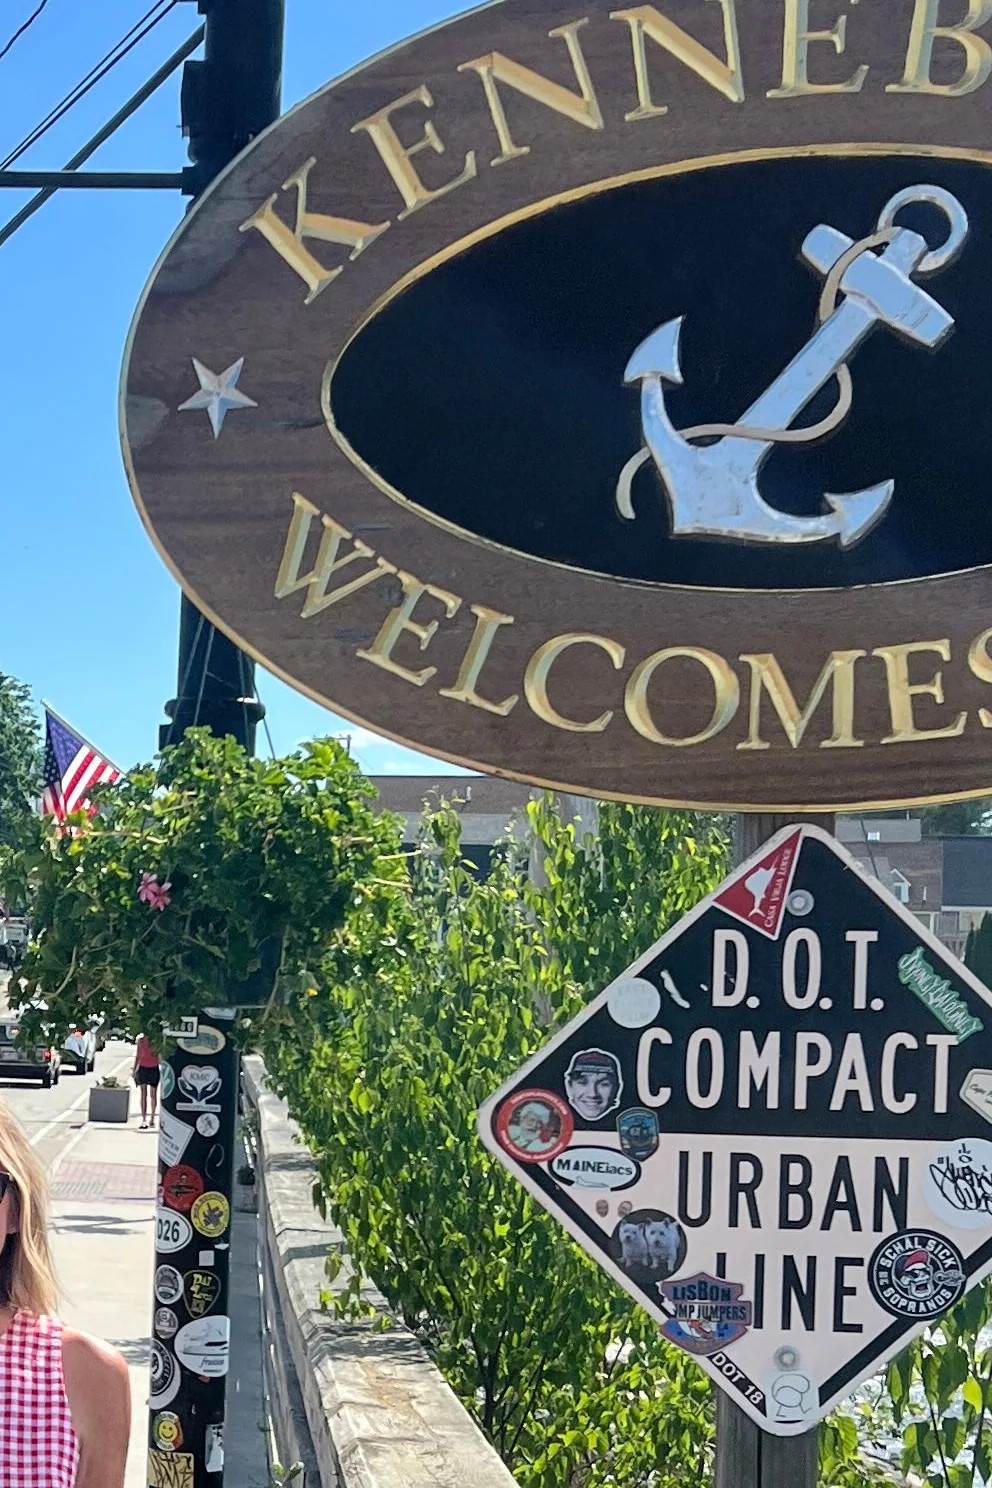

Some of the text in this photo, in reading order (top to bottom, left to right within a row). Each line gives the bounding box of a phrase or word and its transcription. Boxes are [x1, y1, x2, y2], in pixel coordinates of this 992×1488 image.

[636, 1026, 959, 1115] COMPACT
[677, 1150, 910, 1233] URBAN
[879, 1236, 957, 1269] SCHAL SICK
[882, 1286, 953, 1313] SOPRANOS
[711, 1352, 746, 1384] DOT
[743, 1385, 764, 1405] 18
